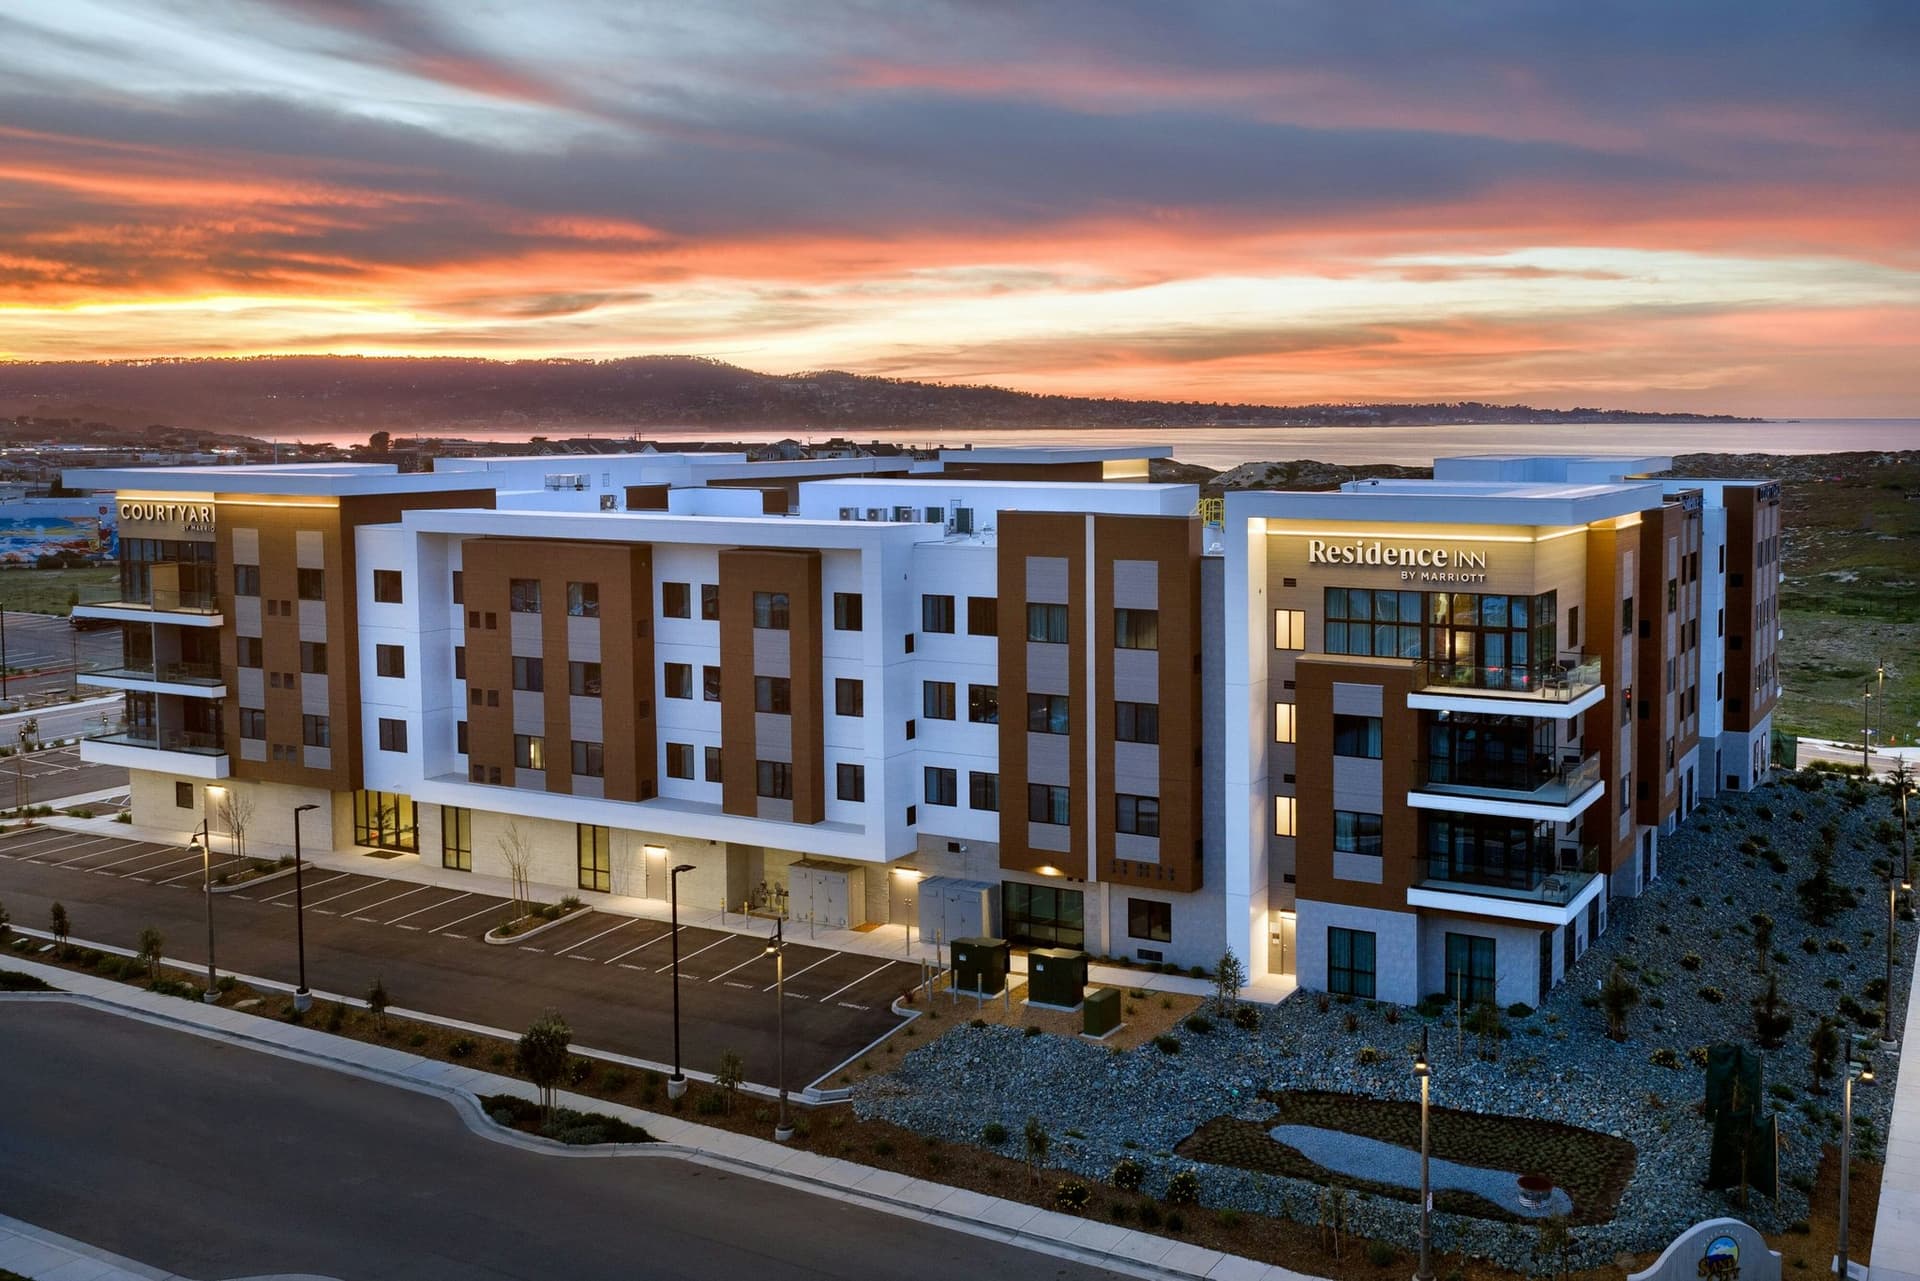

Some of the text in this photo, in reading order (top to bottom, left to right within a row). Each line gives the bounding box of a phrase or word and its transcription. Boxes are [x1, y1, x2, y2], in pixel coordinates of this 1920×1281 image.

[120, 504, 216, 522] COURTYAR
[1309, 540, 1487, 569] Residence INN
[1401, 571, 1486, 583] BY MARRIOTT
